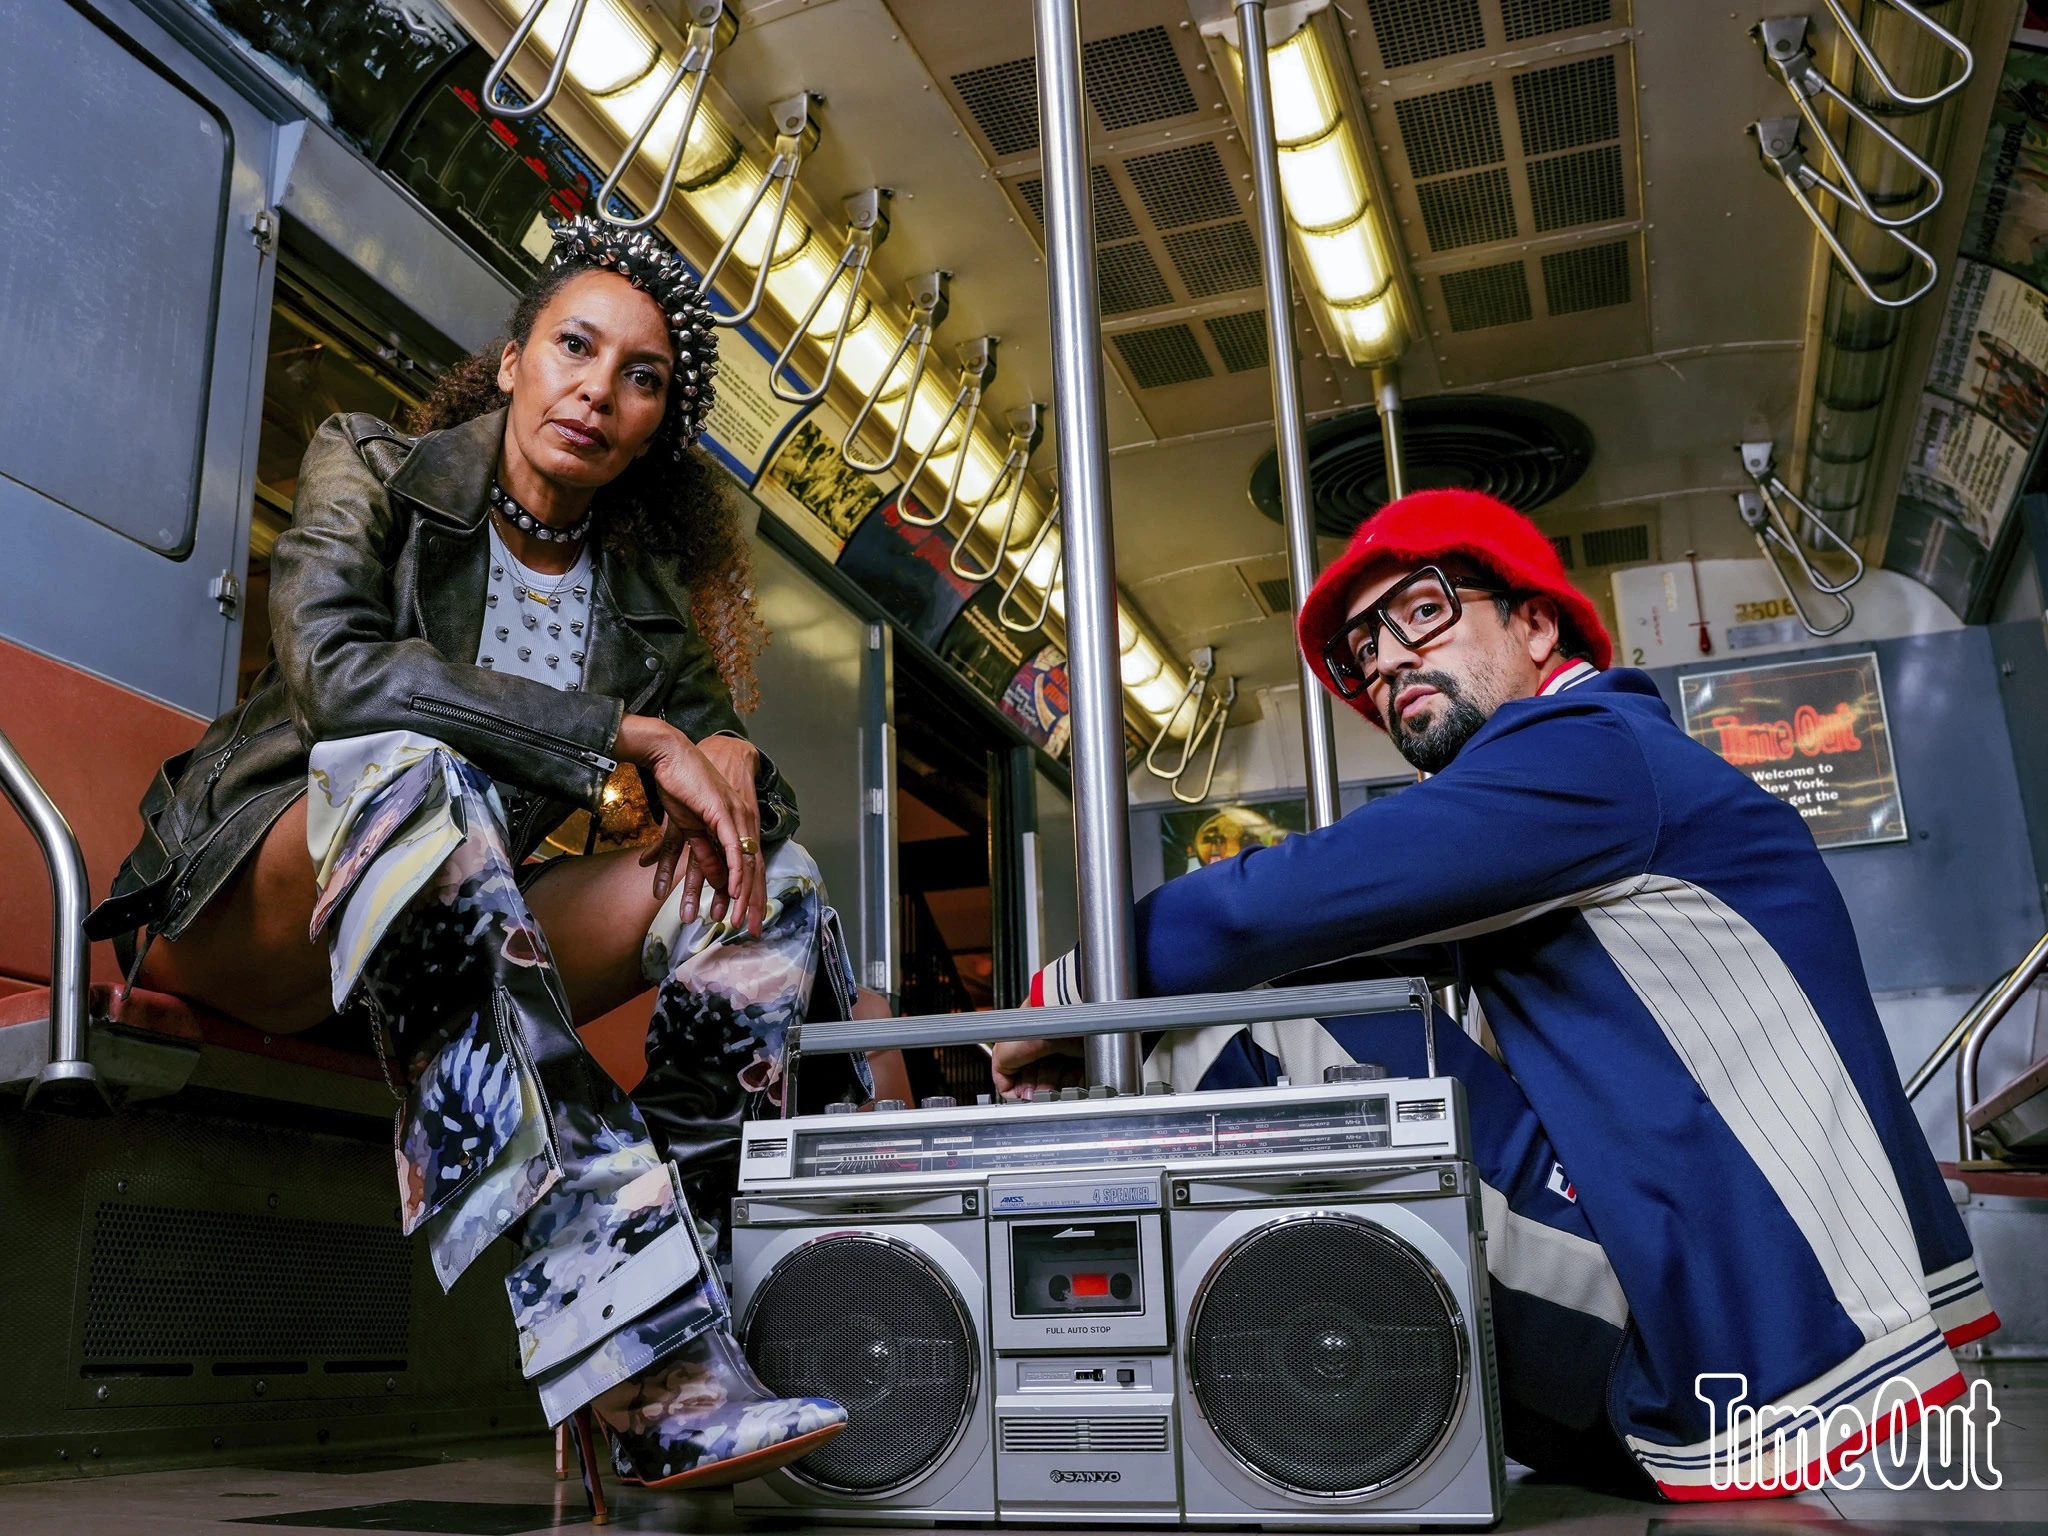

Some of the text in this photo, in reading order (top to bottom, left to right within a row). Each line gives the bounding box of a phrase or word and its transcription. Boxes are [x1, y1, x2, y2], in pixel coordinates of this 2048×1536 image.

[1633, 648, 1646, 665] 2
[1752, 763, 1833, 782] Welcome to
[1794, 778, 1829, 791] York.
[1789, 793, 1813, 807] get
[1816, 791, 1839, 802] the
[1800, 805, 1828, 818] out.
[1000, 1186, 1150, 1203] AMSS 4 SPEAKER
[1067, 1326, 1088, 1334] AUTO
[1063, 1471, 1120, 1482] SANYO
